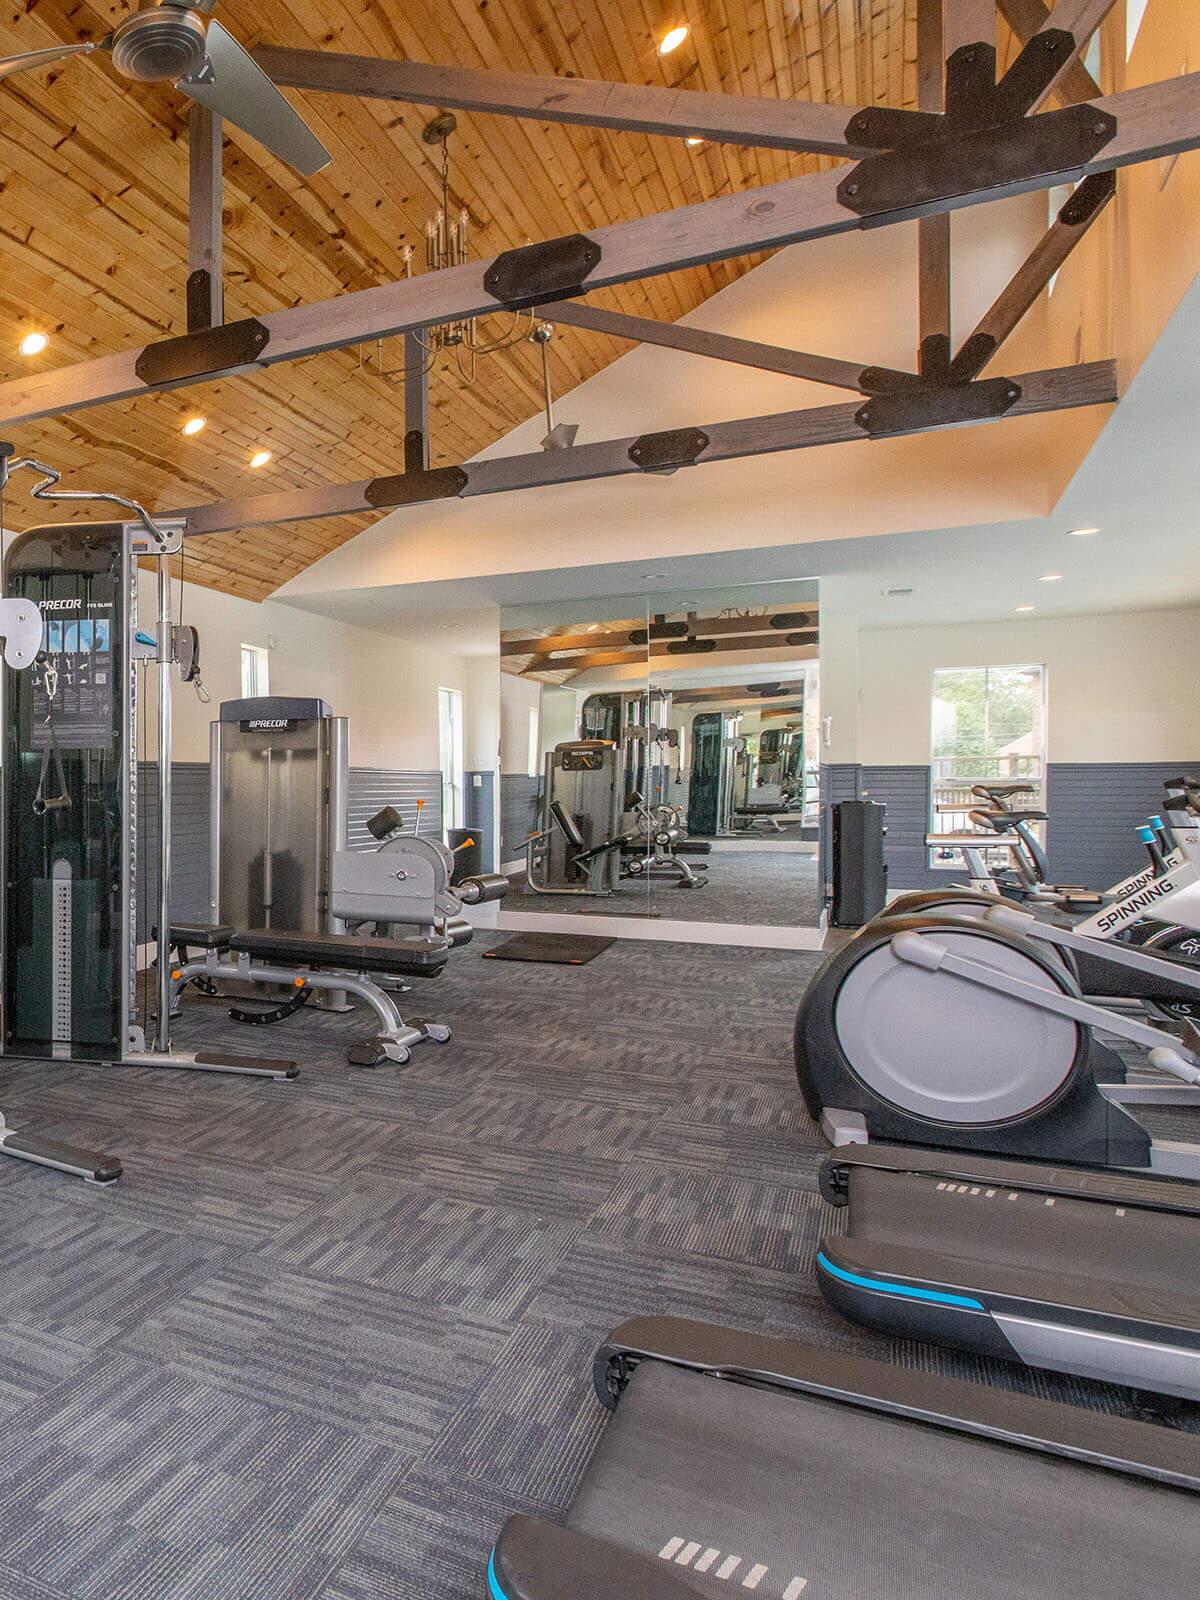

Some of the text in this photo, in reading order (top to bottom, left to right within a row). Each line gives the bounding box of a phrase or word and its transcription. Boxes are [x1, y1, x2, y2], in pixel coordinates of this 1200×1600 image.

[39, 599, 82, 610] PRECOR
[254, 719, 288, 728] PRECOR
[1117, 857, 1178, 896] SPINNG
[1097, 878, 1174, 933] SPINNING
